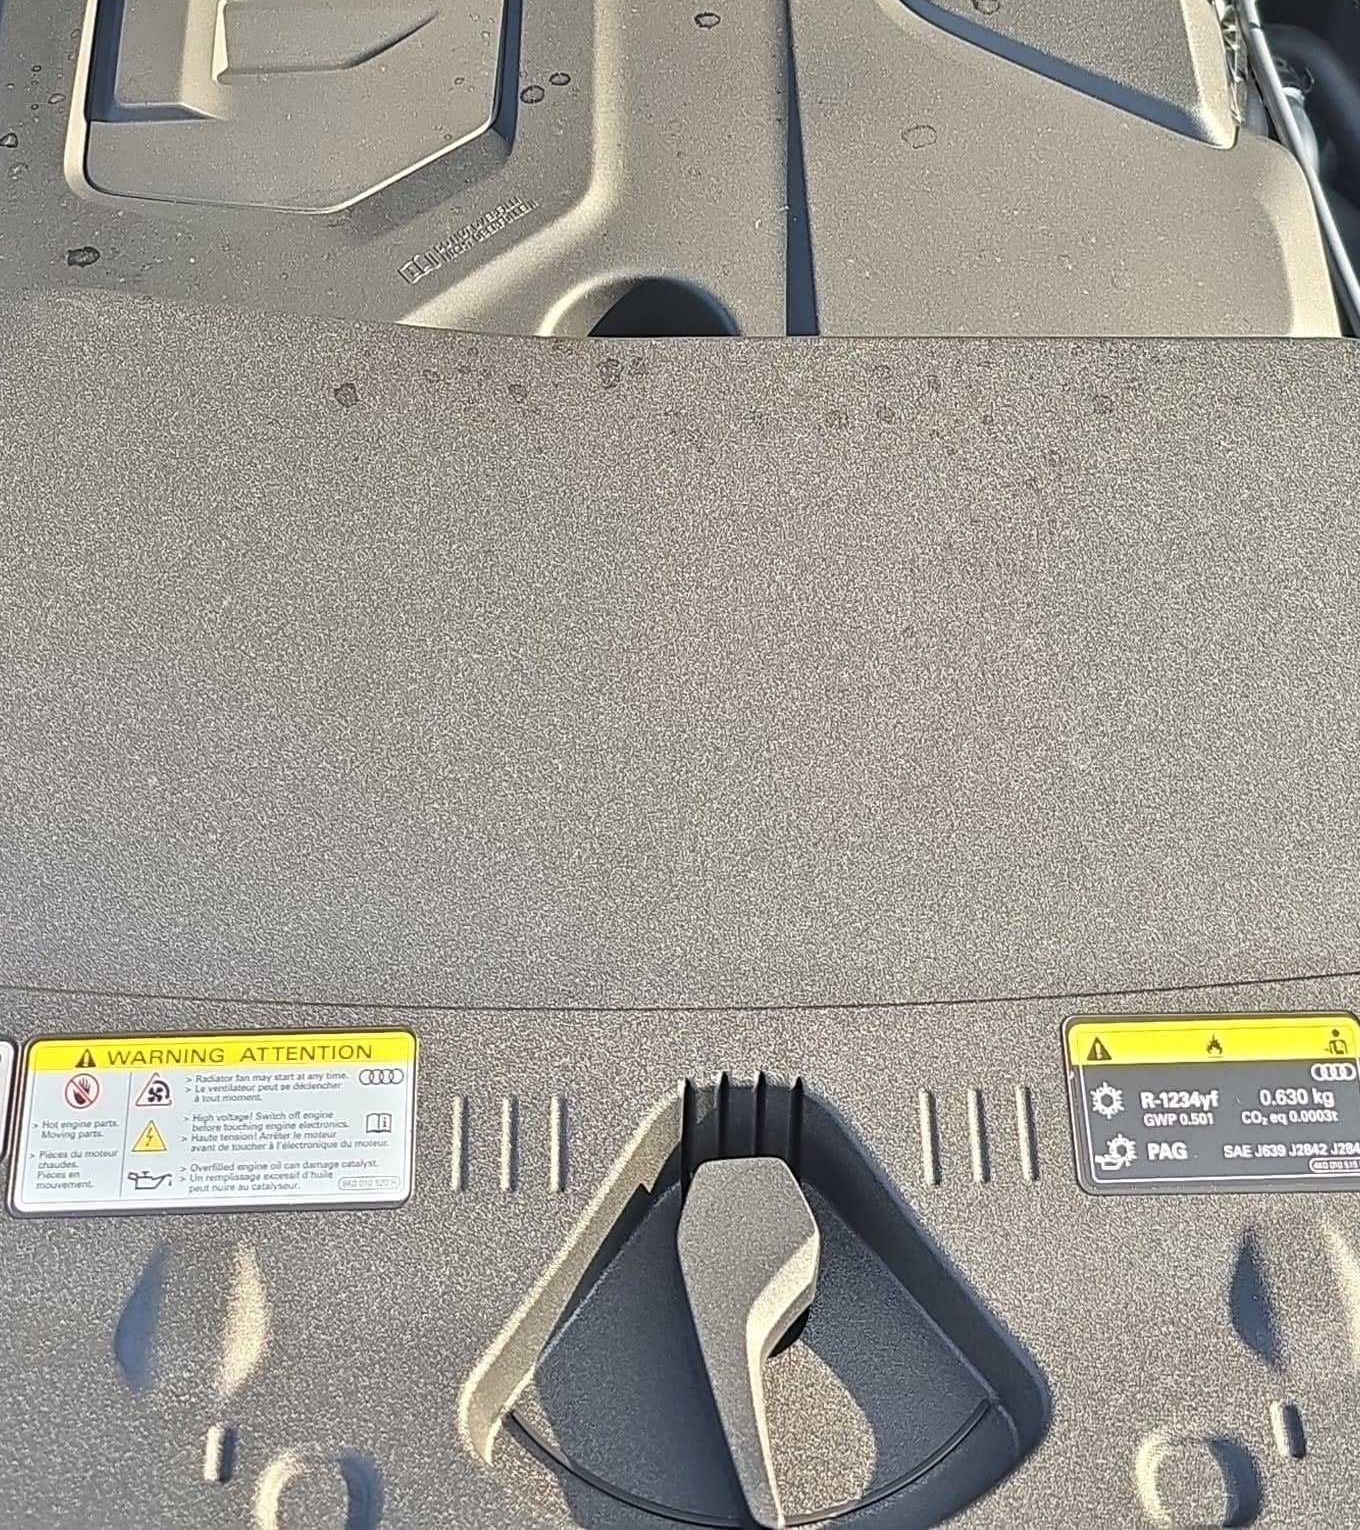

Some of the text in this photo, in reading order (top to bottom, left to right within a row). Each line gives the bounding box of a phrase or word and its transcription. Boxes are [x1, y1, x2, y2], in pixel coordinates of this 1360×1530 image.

[107, 1044, 373, 1066] WARNING ATTENTION
[195, 1074, 234, 1084] Radiator
[235, 1073, 252, 1083] fan
[254, 1073, 272, 1084] may
[273, 1072, 295, 1082] start
[296, 1072, 306, 1081] at
[307, 1072, 324, 1082] any
[194, 1084, 206, 1093] Le
[208, 1083, 255, 1093] ventilateur
[257, 1083, 278, 1093] peut
[279, 1083, 291, 1092] se
[202, 1094, 221, 1103] tout
[1139, 1089, 1220, 1110] R-1234yf
[1258, 1088, 1335, 1108] 0.630 kg
[192, 1114, 215, 1124] High
[255, 1112, 287, 1121] Switch
[288, 1111, 301, 1120] off
[302, 1111, 334, 1121] engine
[1143, 1111, 1215, 1127] GWP 0.501
[1270, 1113, 1288, 1126] eq
[1288, 1109, 1339, 1123] 0.0003t
[42, 1121, 59, 1130] Hot
[60, 1121, 93, 1130] engine
[191, 1122, 221, 1132] before
[223, 1122, 264, 1132] touching
[265, 1121, 297, 1131] engine
[41, 1130, 76, 1140] Moving
[191, 1133, 218, 1143] Haute
[293, 1131, 302, 1140] le
[303, 1130, 337, 1139] moteur
[190, 1143, 216, 1152] avant
[217, 1142, 230, 1152] de
[231, 1141, 267, 1151] toucher
[340, 1139, 353, 1148] du
[1147, 1142, 1189, 1161] PAG
[1223, 1144, 1253, 1159] SAE
[1254, 1143, 1287, 1158] J639
[1288, 1142, 1328, 1157] J2842
[70, 1150, 83, 1159] du
[85, 1150, 119, 1158] moteur
[190, 1162, 236, 1173] Overfilled
[237, 1162, 269, 1173] engine
[270, 1161, 282, 1171] oil
[283, 1161, 301, 1170] can
[302, 1160, 340, 1171] damage
[68, 1171, 81, 1179] en
[190, 1173, 204, 1183] Un
[205, 1172, 262, 1183] remplissage
[263, 1171, 300, 1181] excessif
[188, 1183, 210, 1194] peut
[211, 1182, 236, 1192] nuire
[237, 1183, 250, 1192] au
